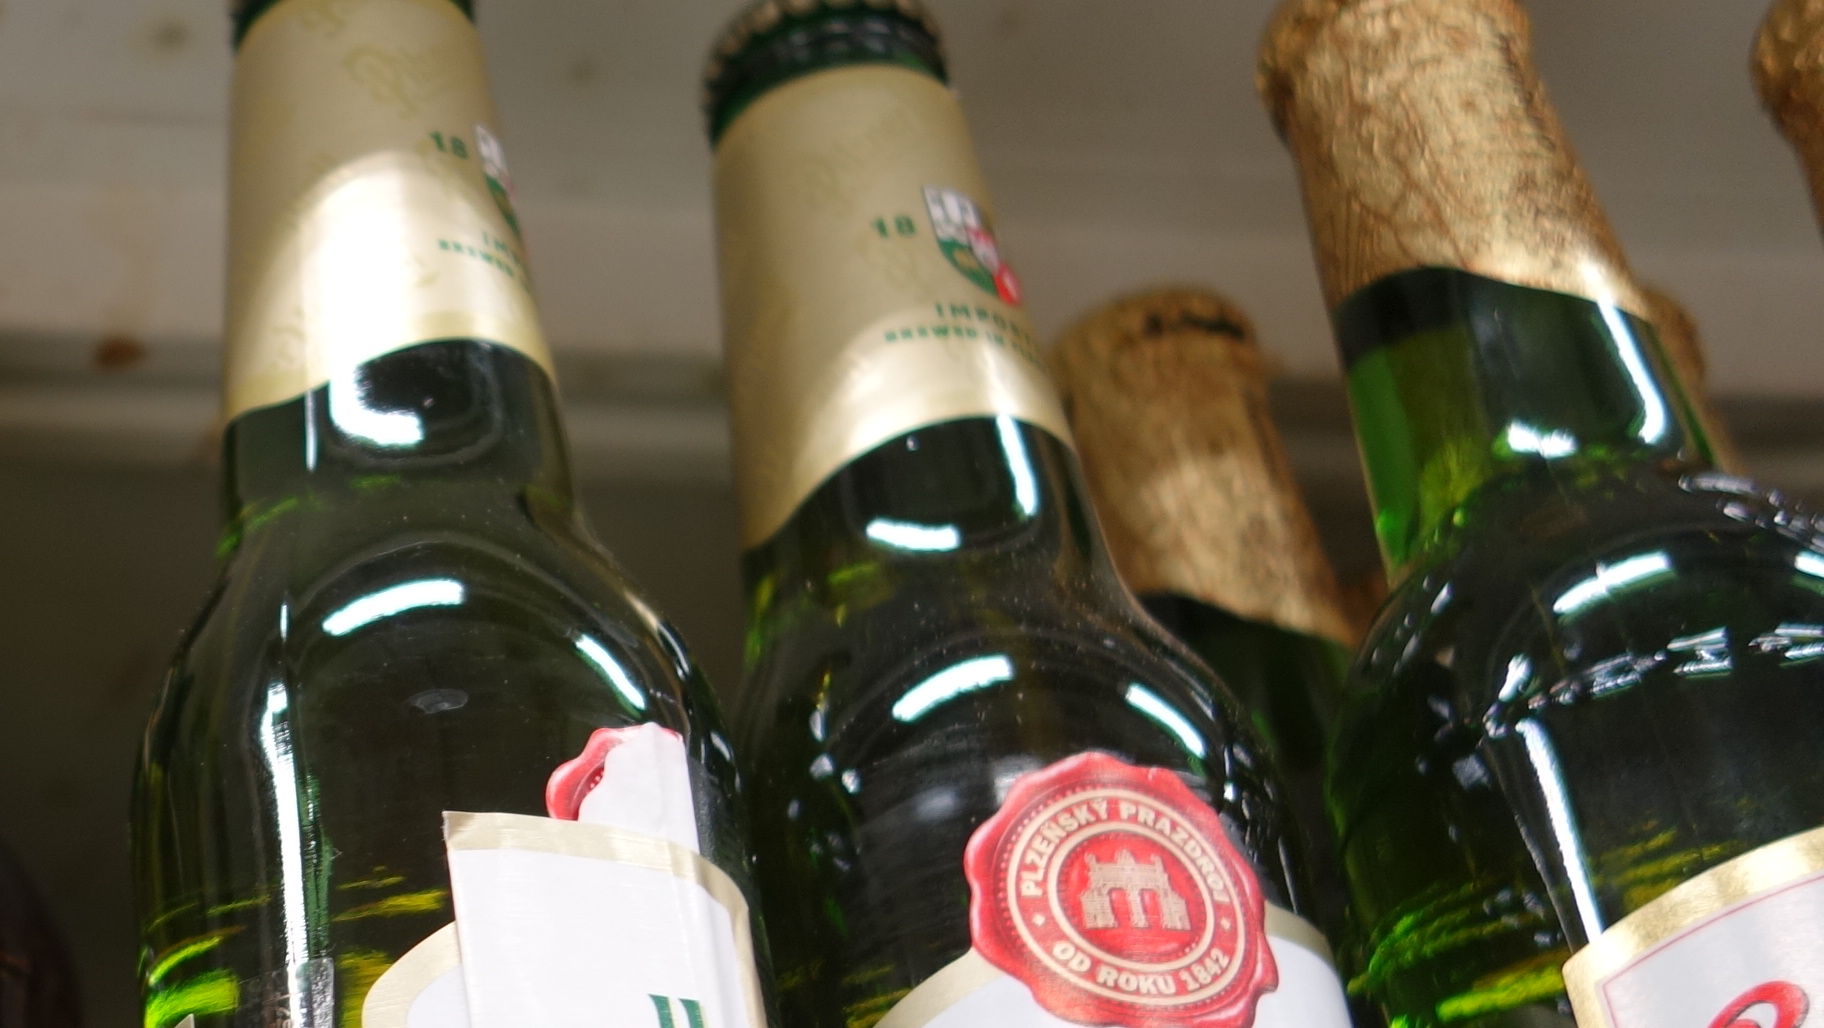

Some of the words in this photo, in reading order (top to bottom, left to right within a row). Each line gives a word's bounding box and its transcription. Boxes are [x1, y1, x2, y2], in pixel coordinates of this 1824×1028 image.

[1052, 939, 1092, 973] OD
[1096, 963, 1177, 995] ROKU
[1179, 946, 1231, 992] 1842
